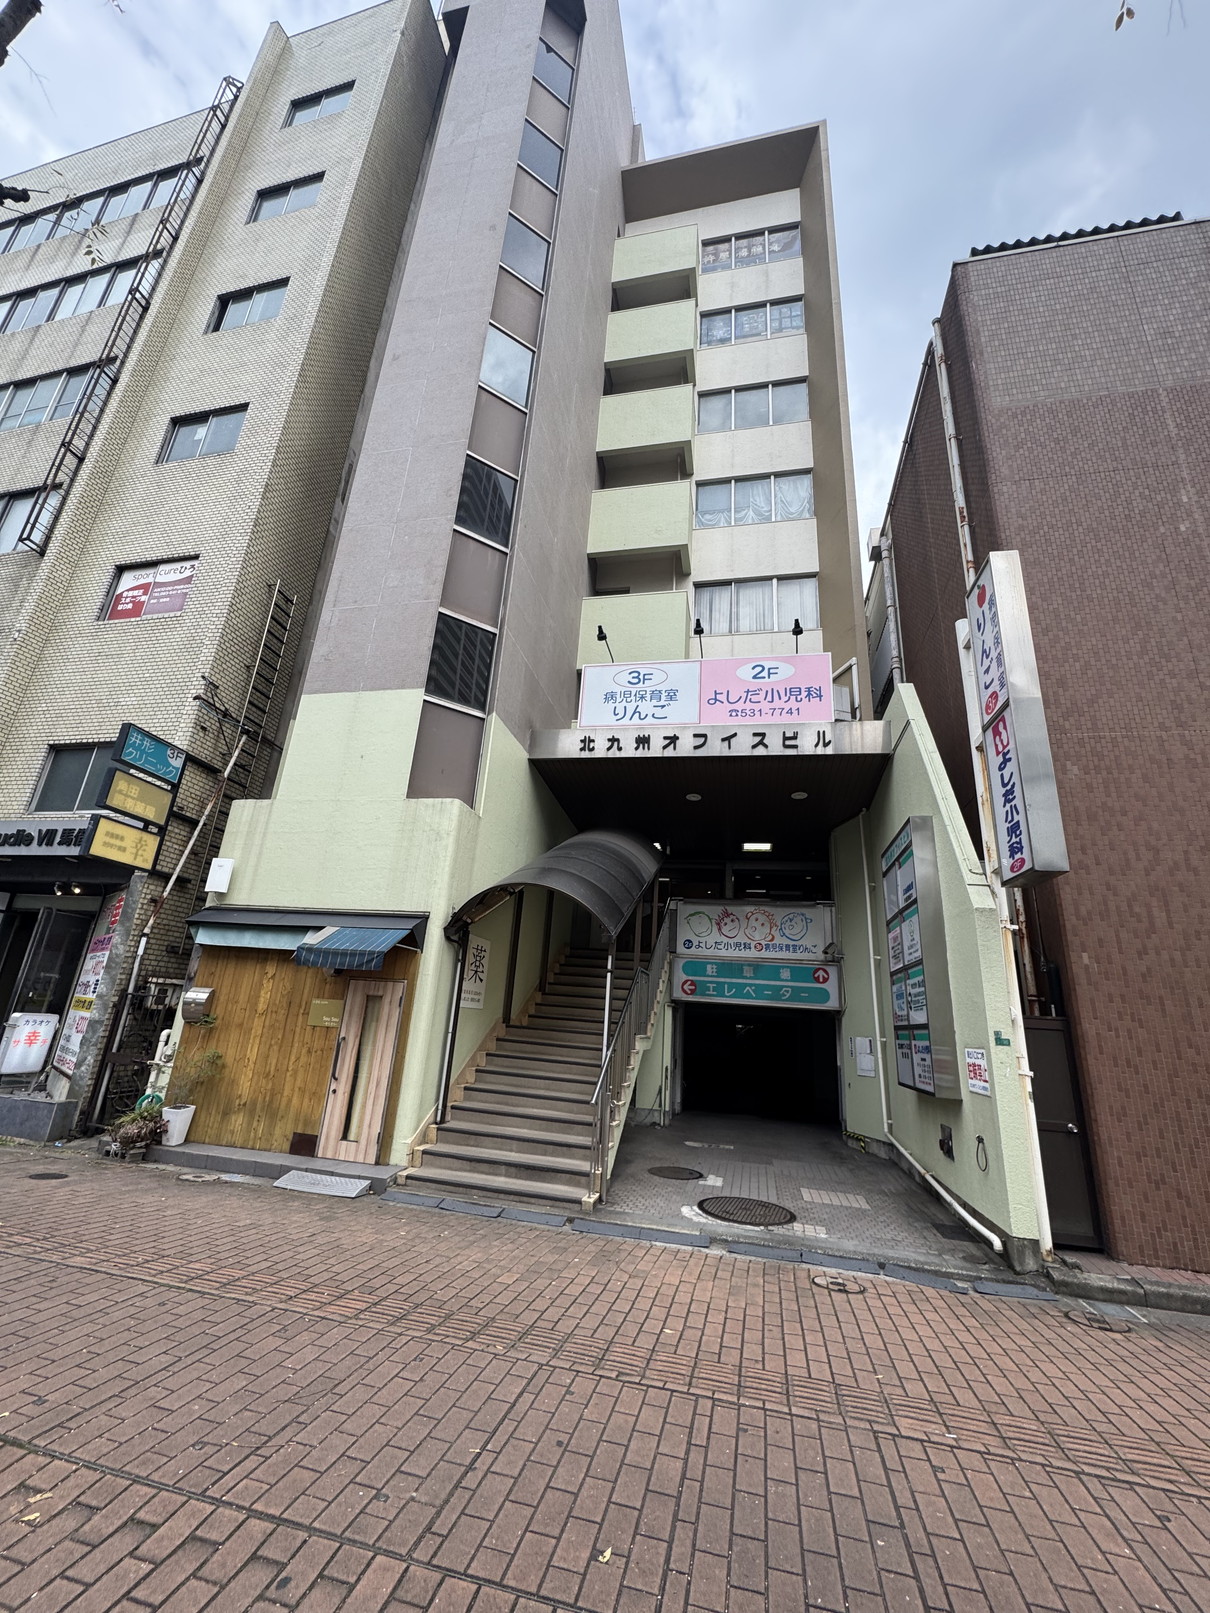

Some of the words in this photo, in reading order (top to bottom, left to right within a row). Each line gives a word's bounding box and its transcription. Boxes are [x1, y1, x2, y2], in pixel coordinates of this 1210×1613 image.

[977, 610, 995, 690] りんご
[626, 670, 654, 685] 3F
[751, 664, 779, 680] 2F
[603, 689, 679, 704] 病児保育室
[706, 686, 824, 706] よしだ小児科
[612, 704, 671, 722] りんご
[740, 707, 801, 718] 531-7741
[129, 732, 155, 753] 井形
[125, 747, 177, 778] クリニック
[167, 748, 184, 761] 3F
[998, 749, 1024, 861] よしだ小児科
[1012, 859, 1023, 872] 2F
[694, 940, 752, 951] よしだ小児科
[706, 964, 791, 980] 駐車場
[705, 984, 809, 1000] エレベーター
[23, 1019, 51, 1027] カラオケ
[24, 1030, 41, 1048] 幸
